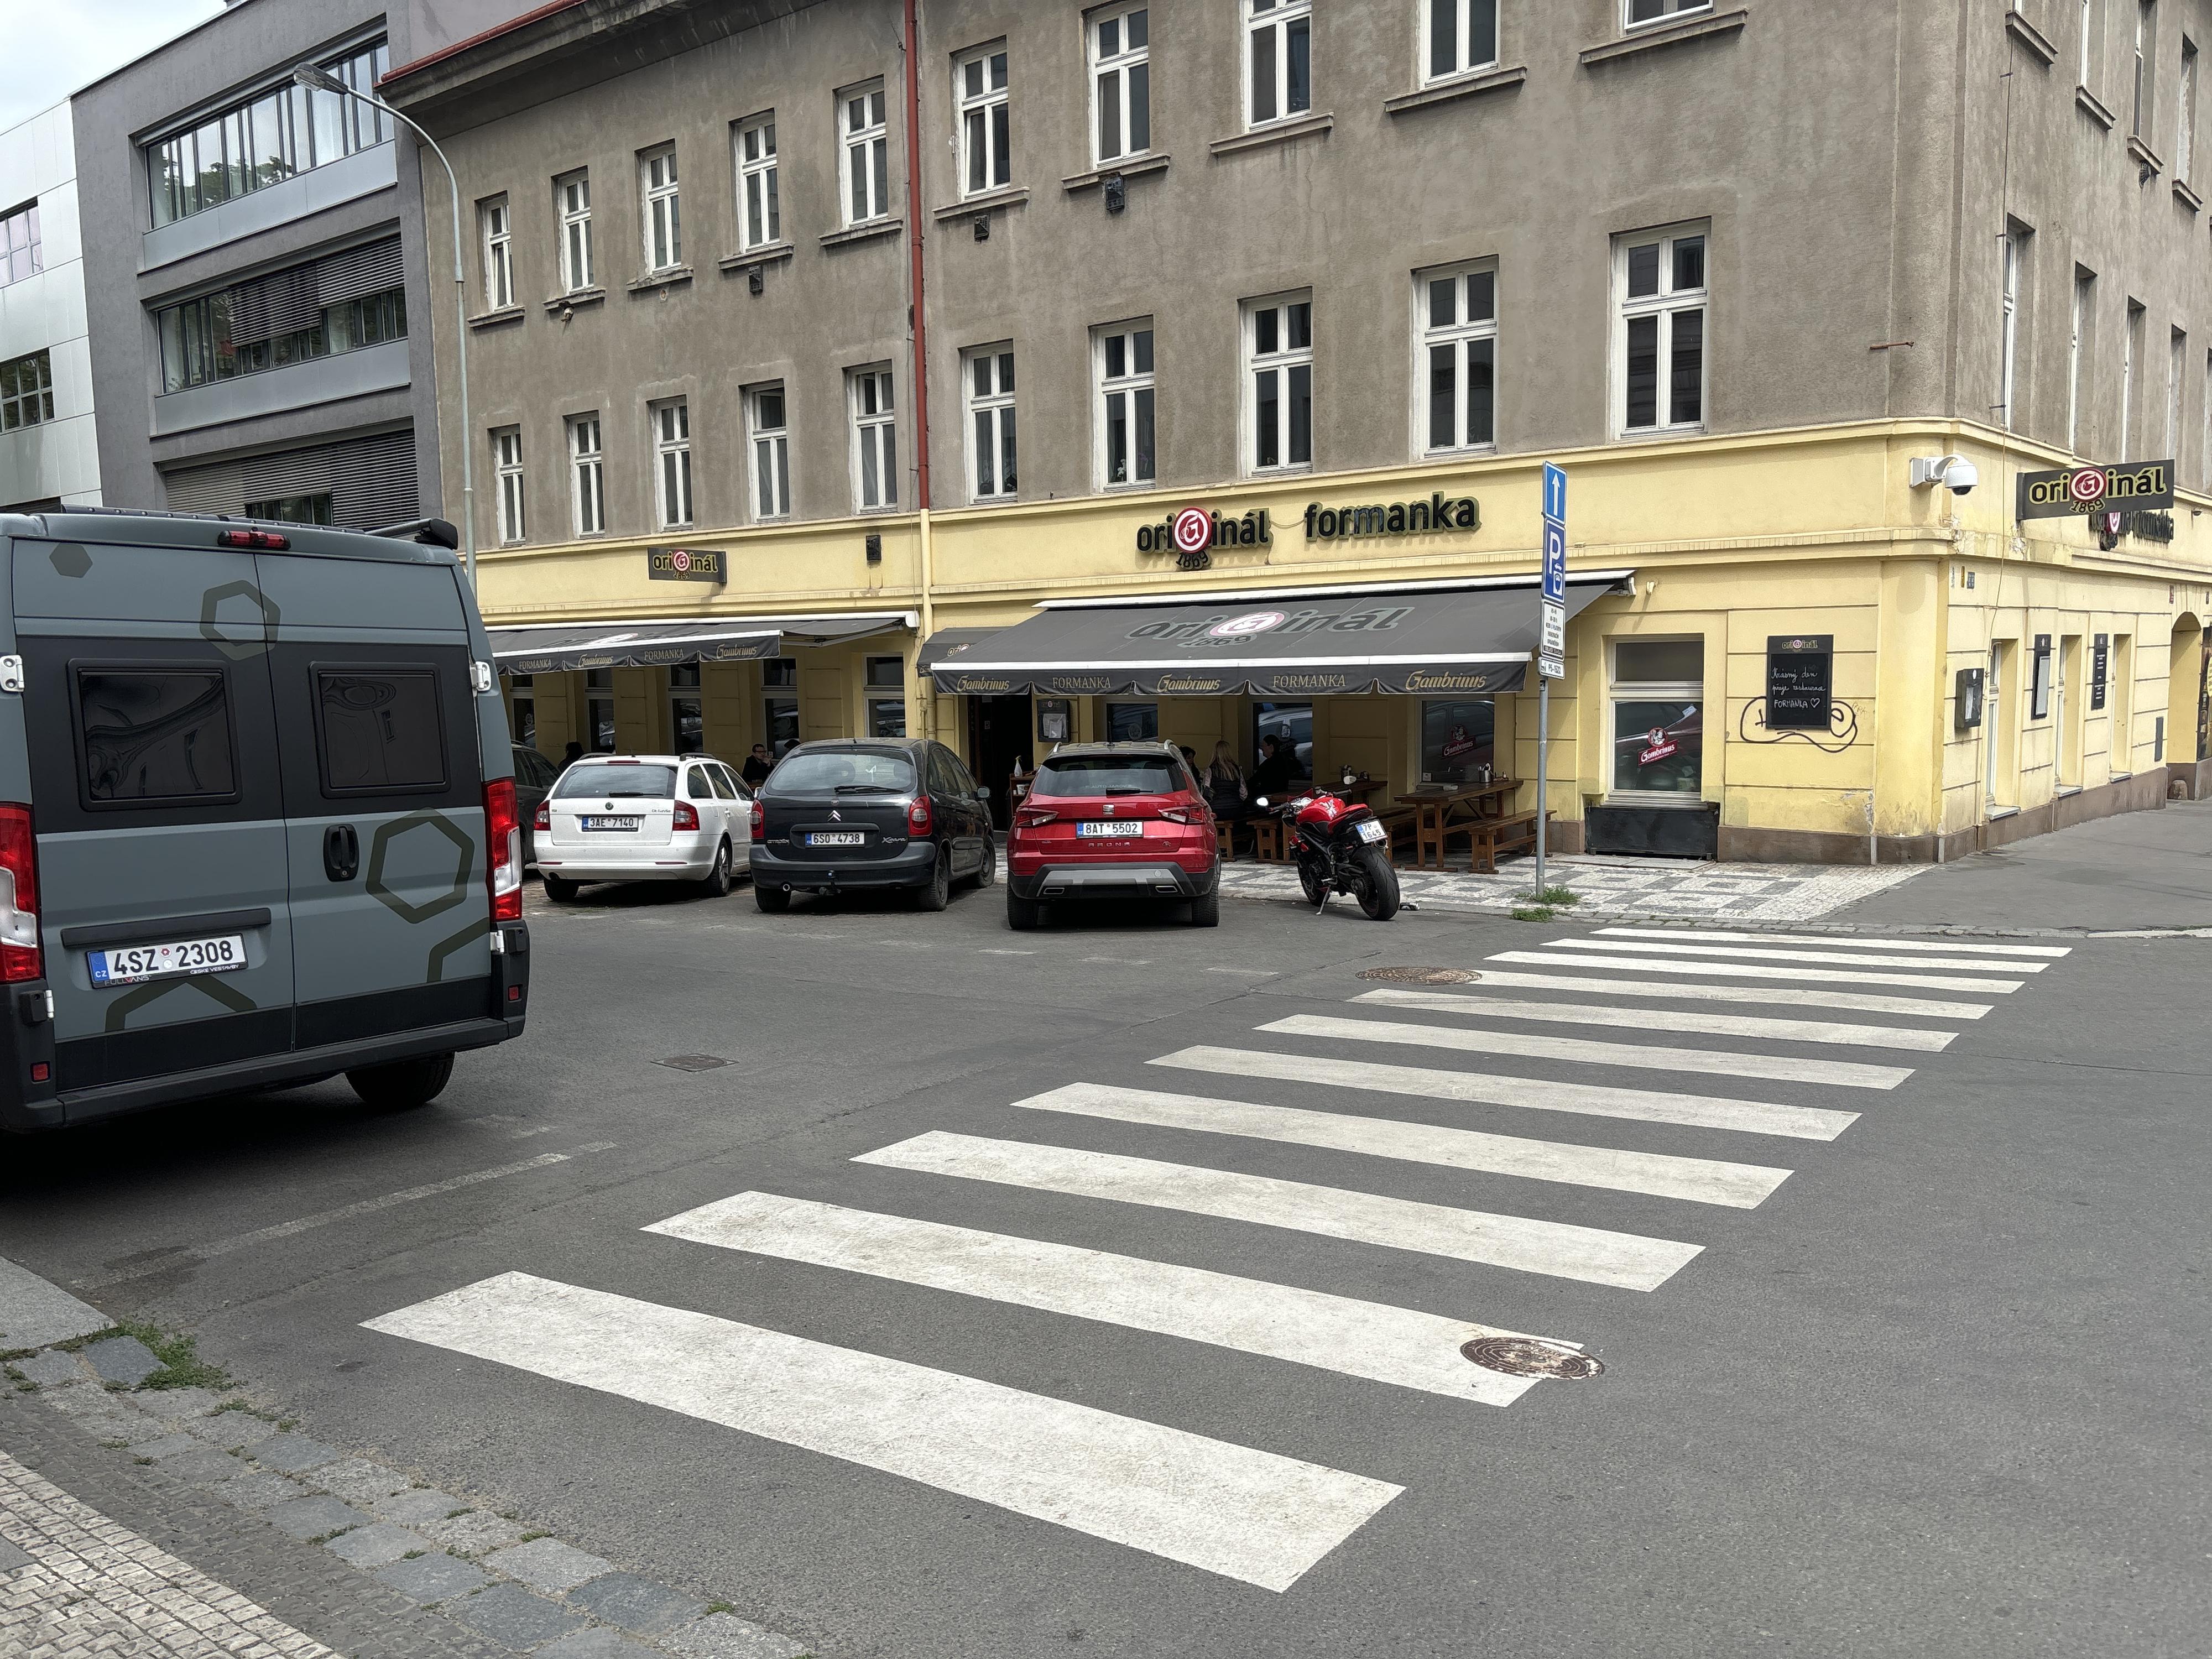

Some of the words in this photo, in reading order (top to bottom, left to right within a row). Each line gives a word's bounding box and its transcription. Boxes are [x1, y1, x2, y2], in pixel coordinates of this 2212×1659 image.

[2070, 498, 2105, 513] 1869
[1304, 493, 1478, 538] formanka
[1176, 552, 1209, 568] 1869
[673, 571, 691, 580] 1869
[1182, 635, 1251, 646] 1869
[644, 648, 684, 661] FORMANKA
[716, 643, 758, 658] Gambrinus
[519, 659, 552, 669] FORMANKA
[578, 654, 613, 667] Gambrinus
[1273, 674, 1346, 688] FORMANKA
[1405, 669, 1487, 690] Gambrinus
[1771, 666, 1798, 683] Krásný
[1802, 666, 1818, 678] den
[957, 674, 1010, 691] Gambrinus
[1052, 676, 1111, 689] FORMANKA
[1157, 672, 1220, 692] Gambrinus
[1793, 682, 1826, 691] restaurace
[1774, 699, 1808, 708] FORMANKA
[1444, 741, 1473, 755] Gambrinus
[1641, 744, 1674, 761] Gambrinus
[590, 818, 606, 827] 3AE
[613, 818, 634, 827] 7140
[1086, 823, 1104, 833] 8AT
[1113, 823, 1138, 833] 5502
[837, 833, 860, 843] 4738
[1363, 830, 1381, 839] 1645
[114, 948, 159, 974] 4SZ
[176, 940, 233, 968] 2308
[210, 964, 239, 973] VESTAVBY
